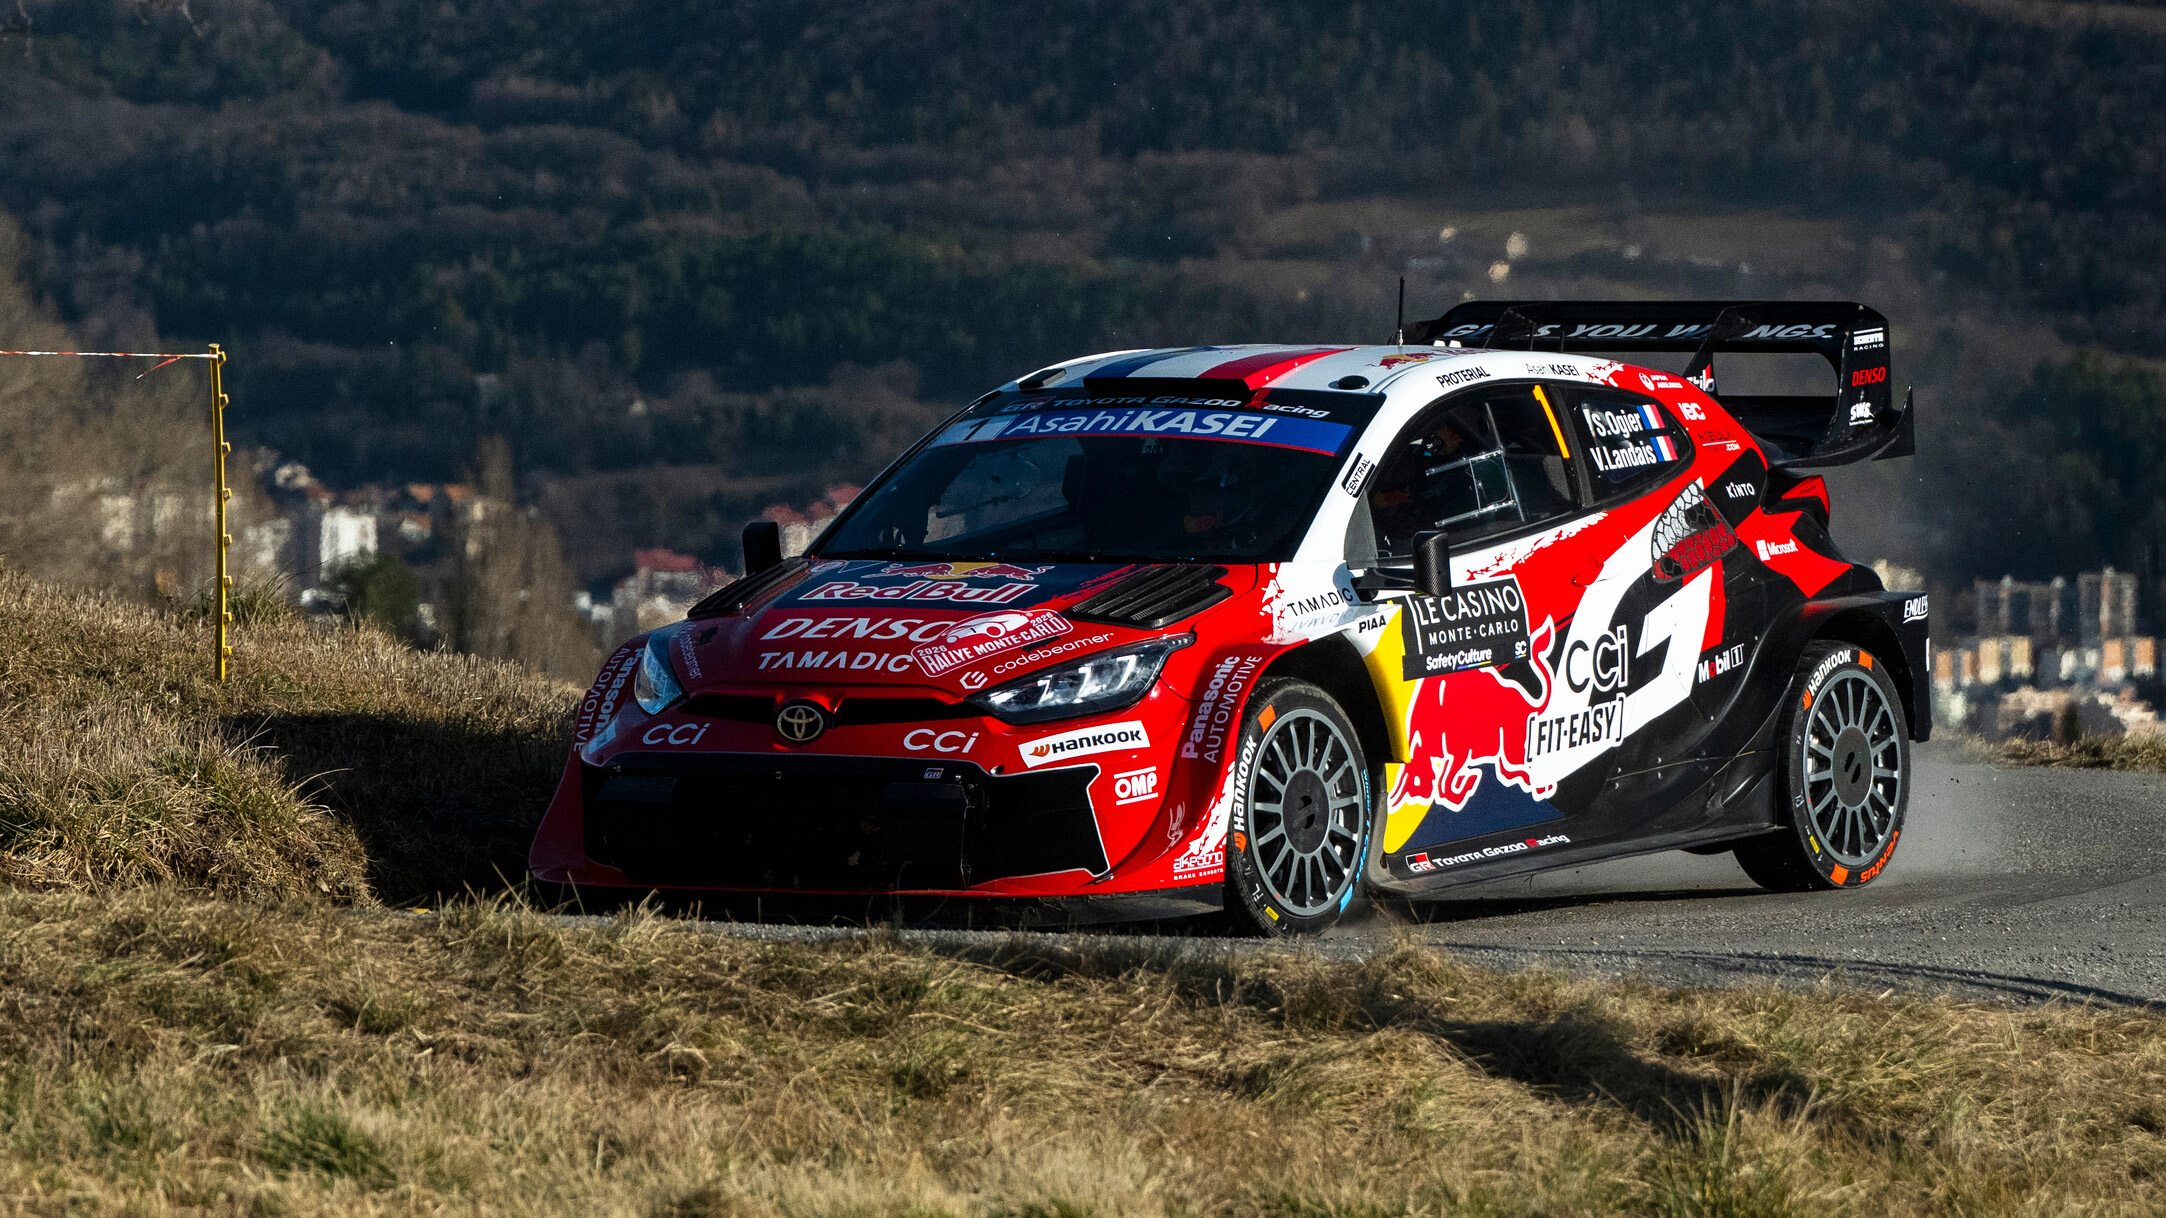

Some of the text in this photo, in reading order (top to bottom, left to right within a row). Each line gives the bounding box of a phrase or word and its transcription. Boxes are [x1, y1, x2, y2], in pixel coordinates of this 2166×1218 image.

[1567, 323, 1657, 337] YOU
[1853, 342, 1884, 352] RACING
[1436, 365, 1491, 388] PROTERIAL
[1852, 366, 1886, 387] DENSO
[1244, 400, 1331, 419] Racing
[962, 418, 991, 440] 1
[1004, 410, 1278, 438] AsahiKASEI
[1533, 385, 1570, 459] 1
[1591, 409, 1643, 438] S.Ogier
[1590, 441, 1657, 471] V.Landais
[1345, 459, 1371, 496] CENTRAL
[1767, 538, 1798, 555] Microsoft
[798, 581, 1039, 604] Red Bull
[1287, 587, 1354, 617] TAMADIC
[1416, 585, 1520, 626] LE CASINO
[760, 617, 957, 643] DENSO
[1031, 612, 1054, 627] 2026
[1358, 615, 1387, 634] PIAA
[917, 645, 948, 657] 2026
[922, 617, 1068, 674] RALLYE MONTE-CARLO
[993, 633, 1112, 674] codebeamer
[758, 652, 913, 672] TAMADIC
[1426, 648, 1492, 671] SafetyCulture
[1698, 653, 1730, 683] Mobil
[1181, 655, 1240, 759] Panasonic
[1204, 655, 1263, 764] AUTOMOTIVE
[924, 768, 943, 779] GR
[1114, 772, 1158, 799] OMP
[1173, 851, 1224, 870] akebono
[1432, 851, 1485, 867] TOYOTA
[1483, 842, 1528, 857] GAZOO
[1526, 834, 1571, 848] Racing
